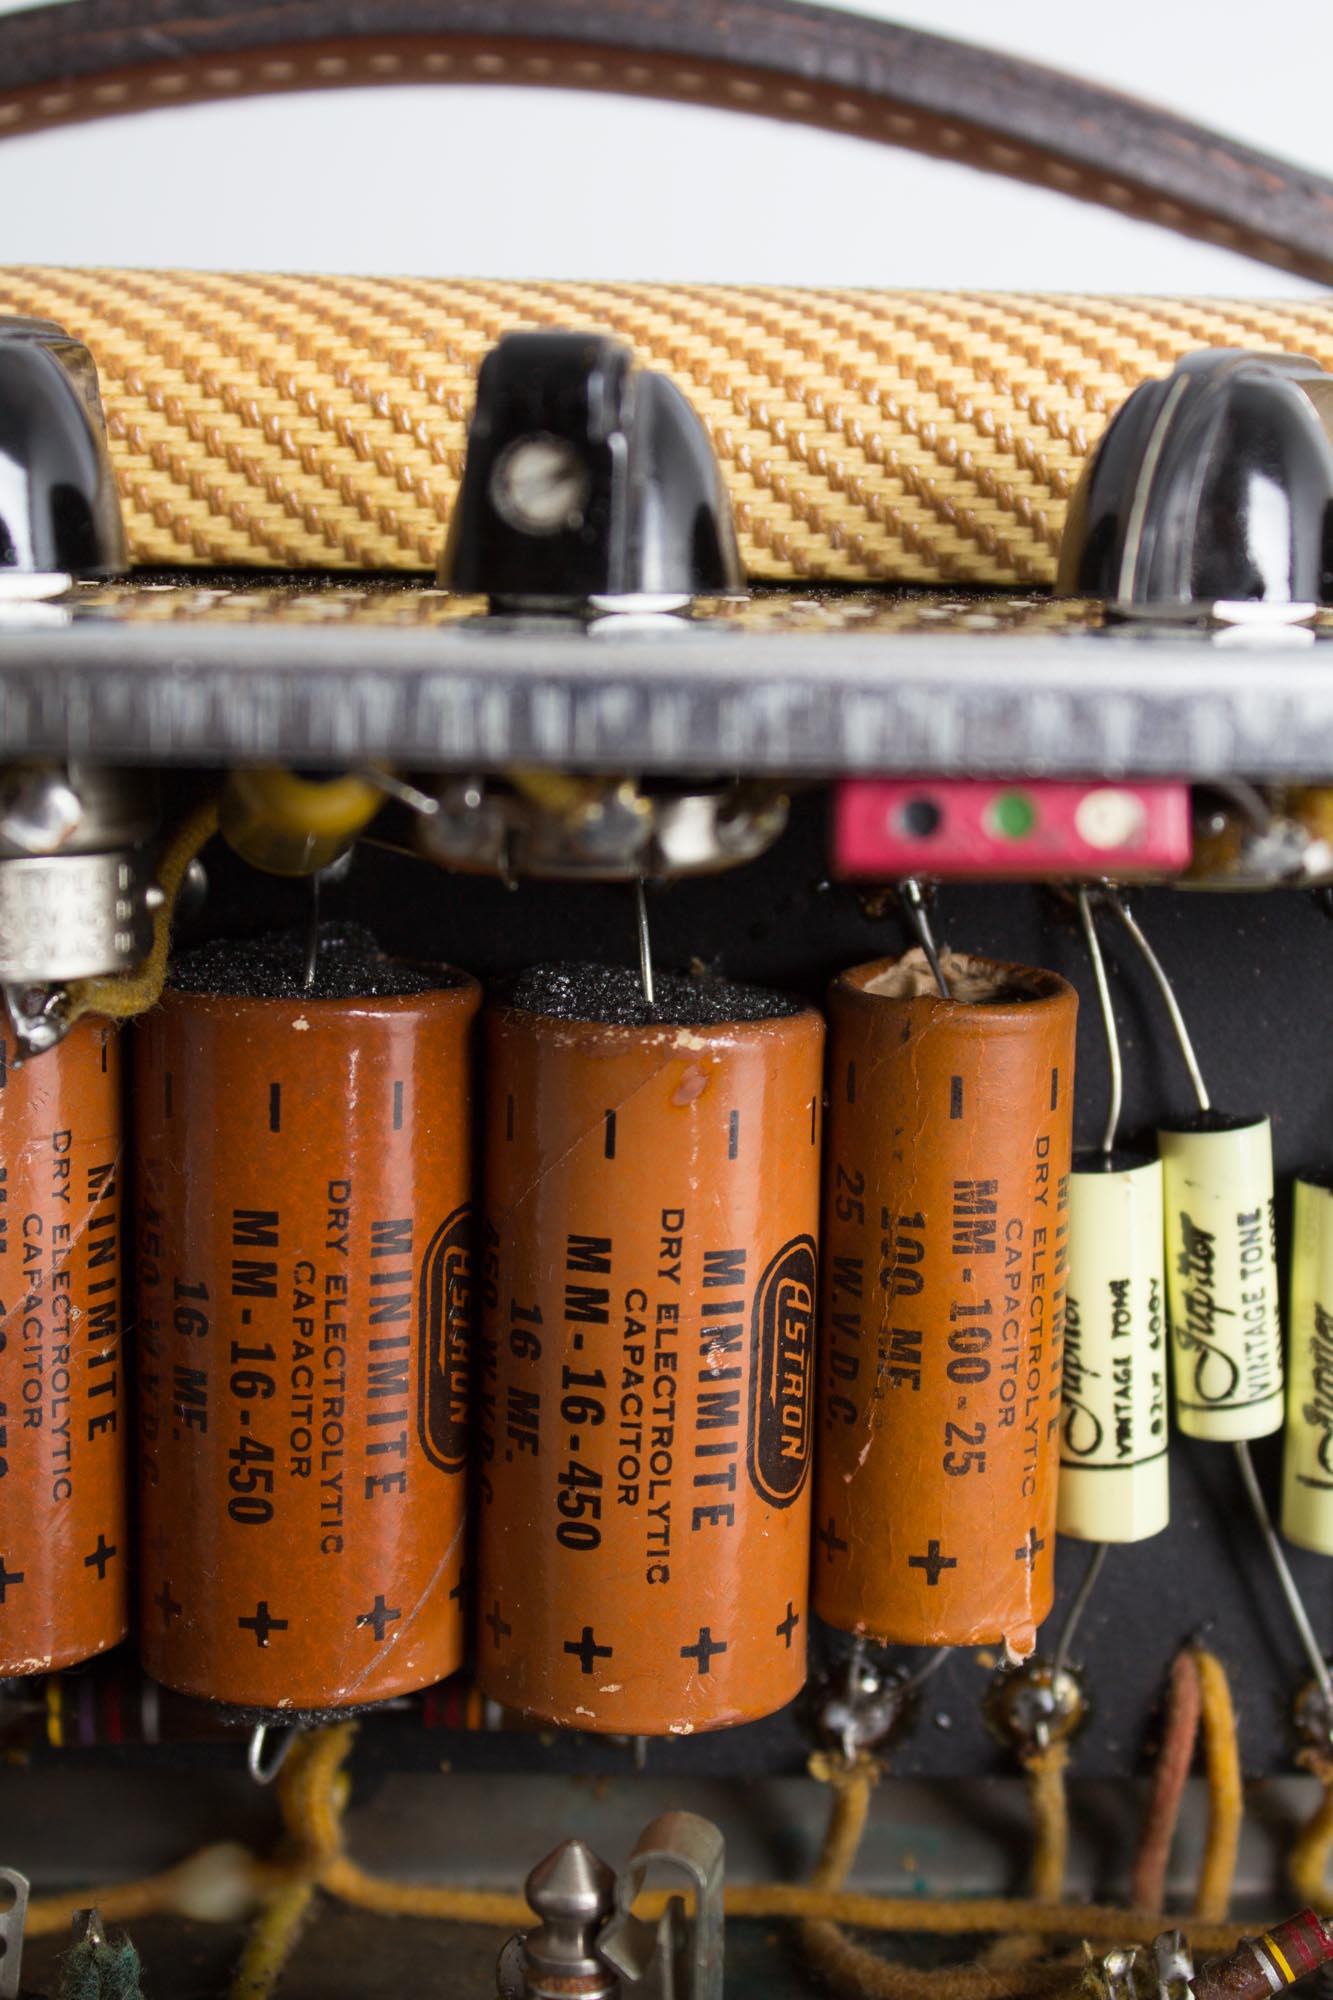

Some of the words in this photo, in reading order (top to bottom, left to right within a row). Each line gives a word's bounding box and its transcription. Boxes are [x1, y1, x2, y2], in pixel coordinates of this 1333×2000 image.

[51, 1130, 71, 1201] DRY
[325, 1180, 350, 1255] DRY
[659, 1208, 684, 1285] DRY
[834, 1164, 865, 1224] 25
[879, 1207, 926, 1297] 100
[1033, 1136, 1050, 1205] DRY
[1236, 1208, 1263, 1280] TONE
[22, 1214, 43, 1429] CAPACITOR
[51, 1224, 71, 1502] ELECTROLYTIC
[87, 1163, 117, 1442] MINIMITE
[173, 1277, 208, 1337] 16
[228, 1209, 279, 1525] MM-16-450
[290, 1261, 315, 1478] CAPACITOR
[364, 1219, 413, 1500] MINIMITE
[438, 1246, 471, 1423] ASTRON
[509, 1299, 542, 1361] 16
[556, 1234, 612, 1551] MM-16-450
[692, 1250, 746, 1531] MINIMITE
[770, 1278, 812, 1459] ASTRON
[826, 1256, 864, 1431] W.V.D.C.
[943, 1179, 998, 1477] MM-100-25
[998, 1219, 1022, 1429] CAPACITOR
[1021, 1227, 1047, 1498] ELECTROLYTIC
[1241, 1288, 1272, 1399] VINTAGE
[172, 1366, 208, 1441] MF.
[321, 1274, 348, 1555] ELECTROLYTIC
[505, 1387, 539, 1463] MF.
[617, 1289, 646, 1506] CAPACITOR
[646, 1304, 679, 1585] ELECTROLYTIC
